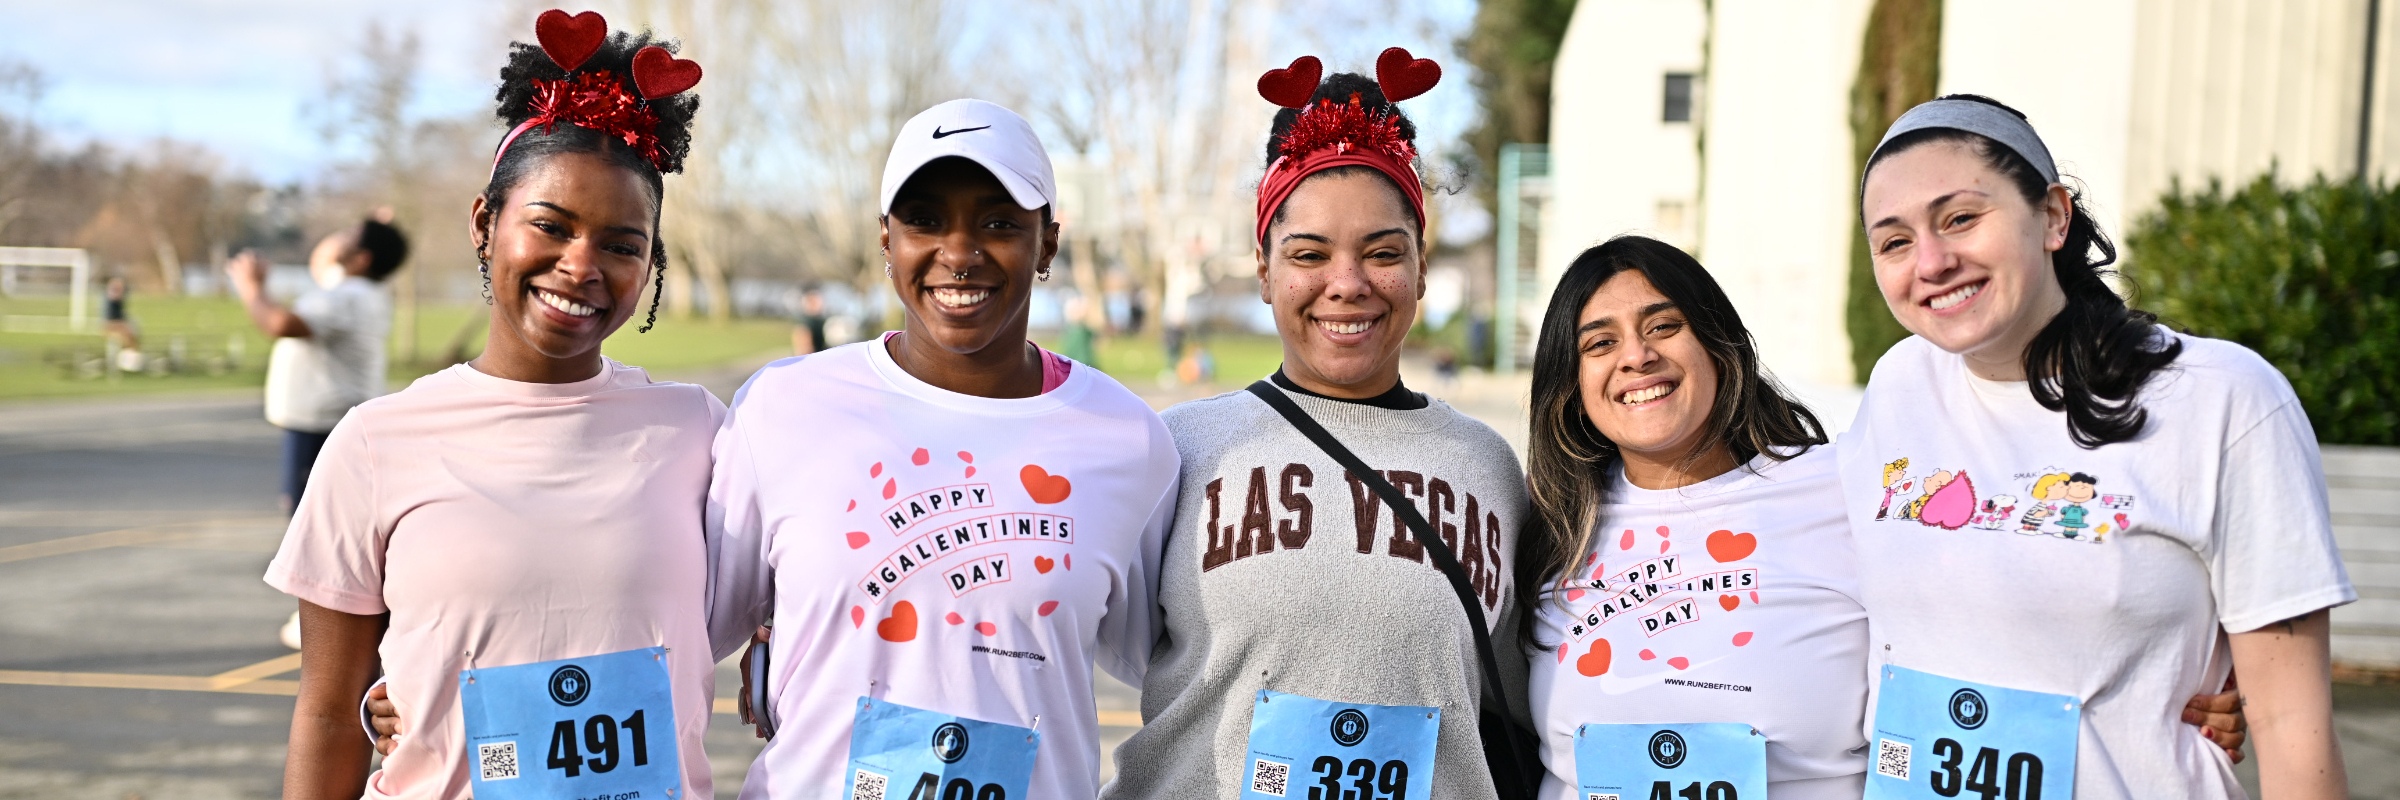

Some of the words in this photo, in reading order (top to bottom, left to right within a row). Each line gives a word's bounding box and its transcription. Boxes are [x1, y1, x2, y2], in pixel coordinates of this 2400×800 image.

[888, 488, 985, 529] HAPPY
[866, 518, 1069, 597] #GALENTINES
[1202, 463, 1313, 572] LAS
[1344, 469, 1501, 612] VEGAS
[950, 560, 1004, 591] DAY
[1590, 558, 1675, 589] HPPY
[1572, 573, 1751, 636] #GALENINES
[1645, 603, 1692, 631] DAY
[1664, 678, 1752, 692] WWW.RUN2BEFIT.COM
[547, 709, 648, 778] 491
[1657, 735, 1677, 744] RUN
[1661, 756, 1675, 764] FIT
[1308, 755, 1408, 800] 339
[1930, 737, 2044, 800] 340
